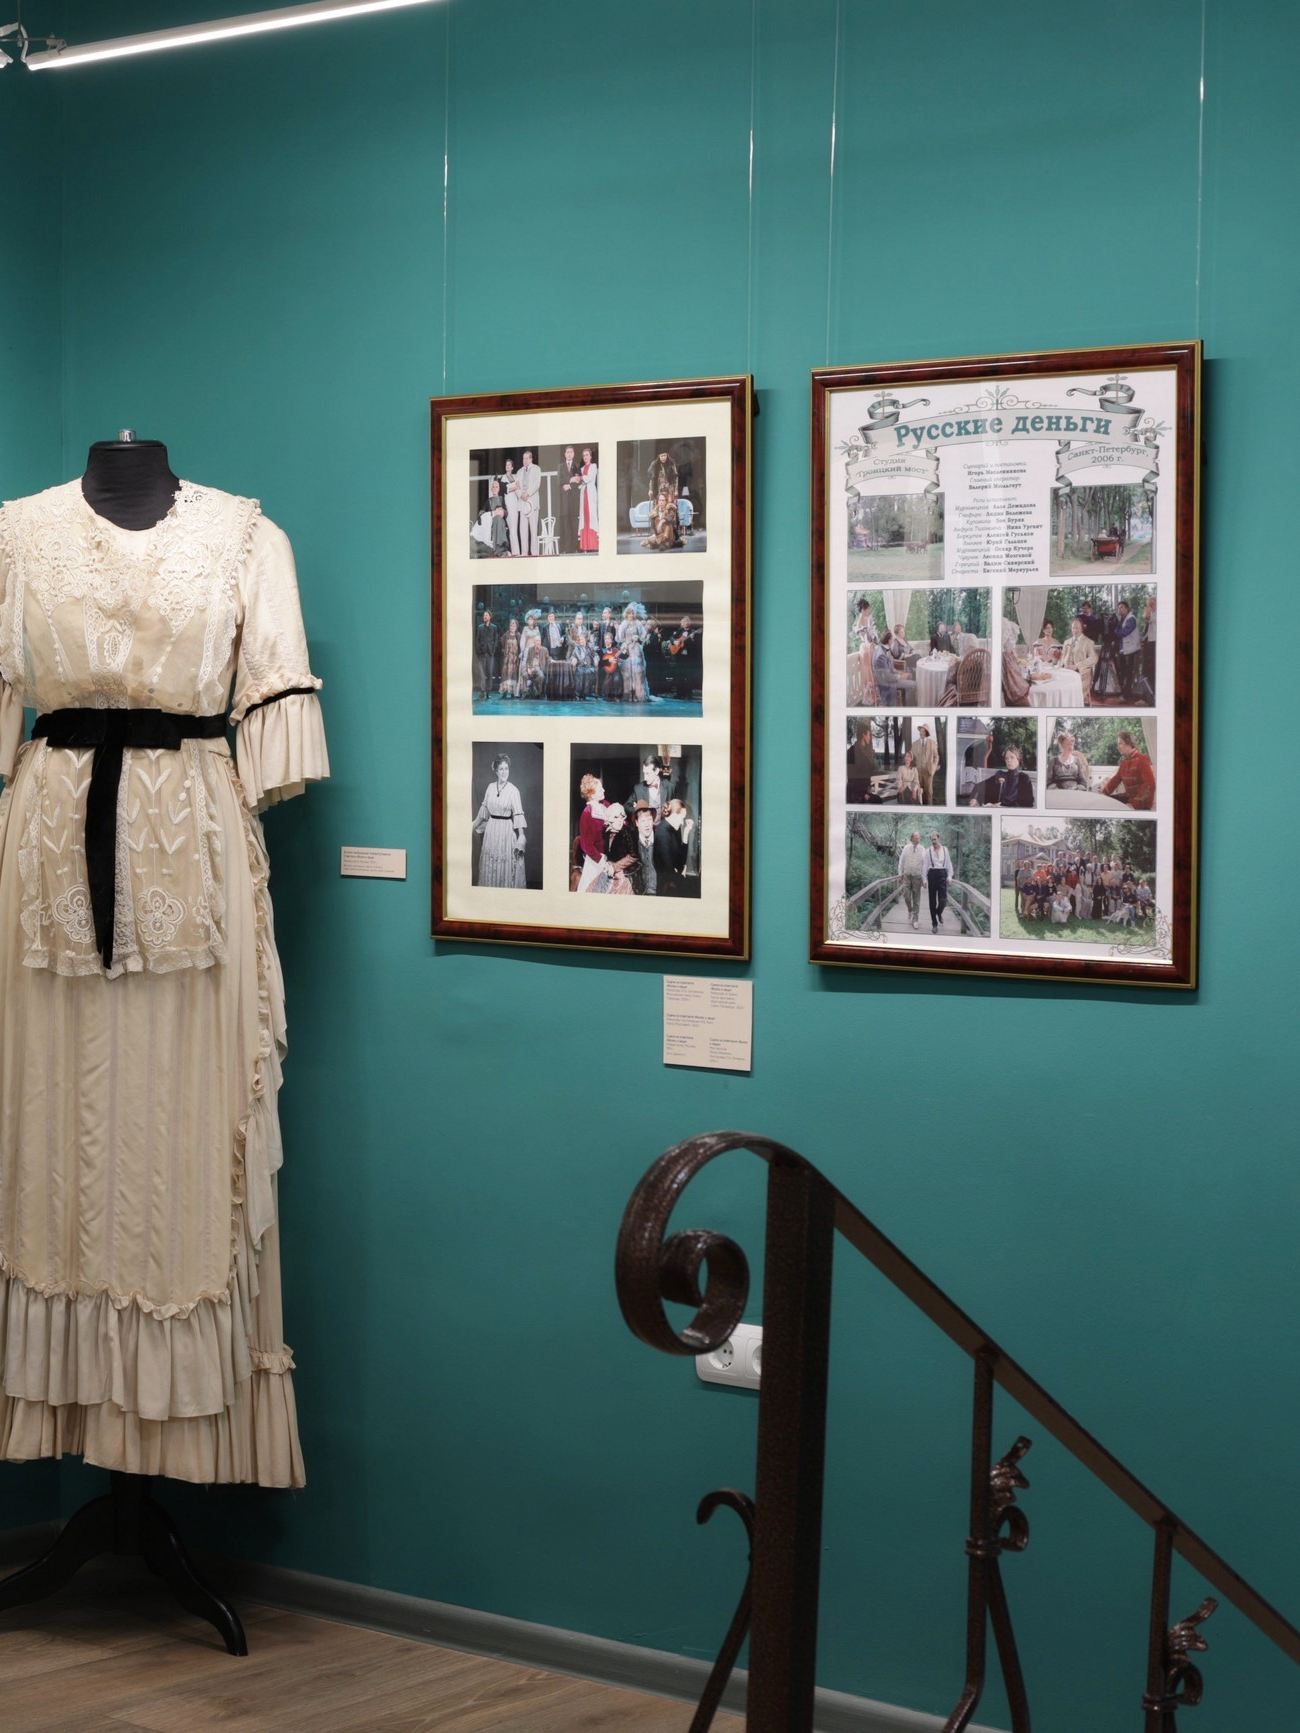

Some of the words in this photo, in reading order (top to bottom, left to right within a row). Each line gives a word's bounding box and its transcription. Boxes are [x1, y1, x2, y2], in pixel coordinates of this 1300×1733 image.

[894, 416, 1003, 449] Русские
[1011, 415, 1112, 436] деньги
[1068, 445, 1148, 460] Санкт-Петербург,
[1092, 455, 1114, 463] 2006
[856, 466, 901, 477] Троицкий
